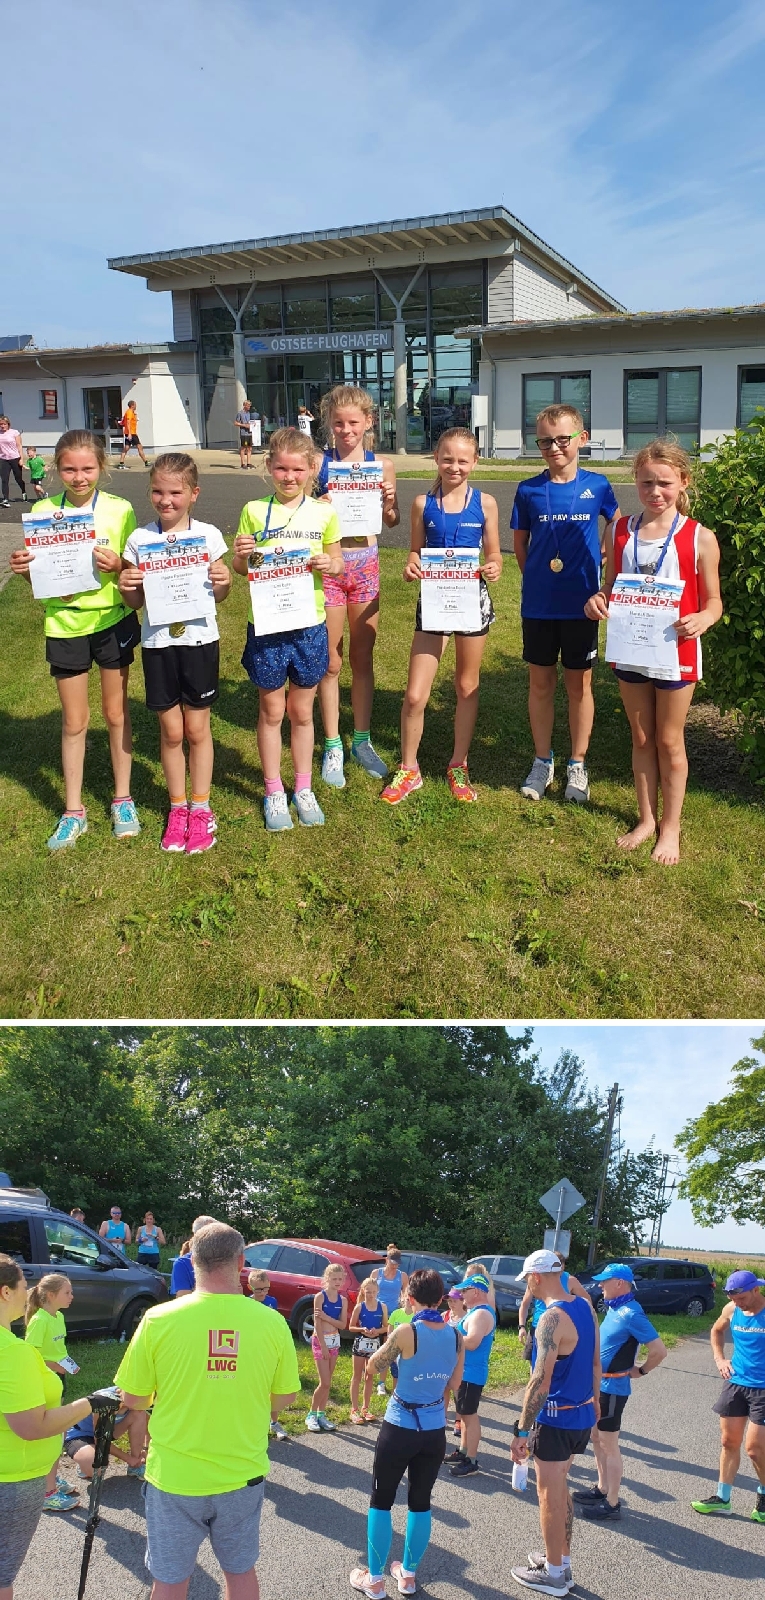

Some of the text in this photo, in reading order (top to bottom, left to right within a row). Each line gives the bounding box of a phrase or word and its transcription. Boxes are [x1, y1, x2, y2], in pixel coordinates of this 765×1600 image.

[271, 332, 388, 351] OSTSEE-FLUGHAFEN
[331, 482, 380, 490] URKUNDE
[29, 531, 93, 546] URKUNDE
[144, 554, 206, 571] URKUNDE
[252, 566, 310, 581] URKUNDE
[424, 571, 476, 579] URKUNDE
[613, 594, 675, 606] URKUNDE
[207, 1360, 237, 1371] LWG
